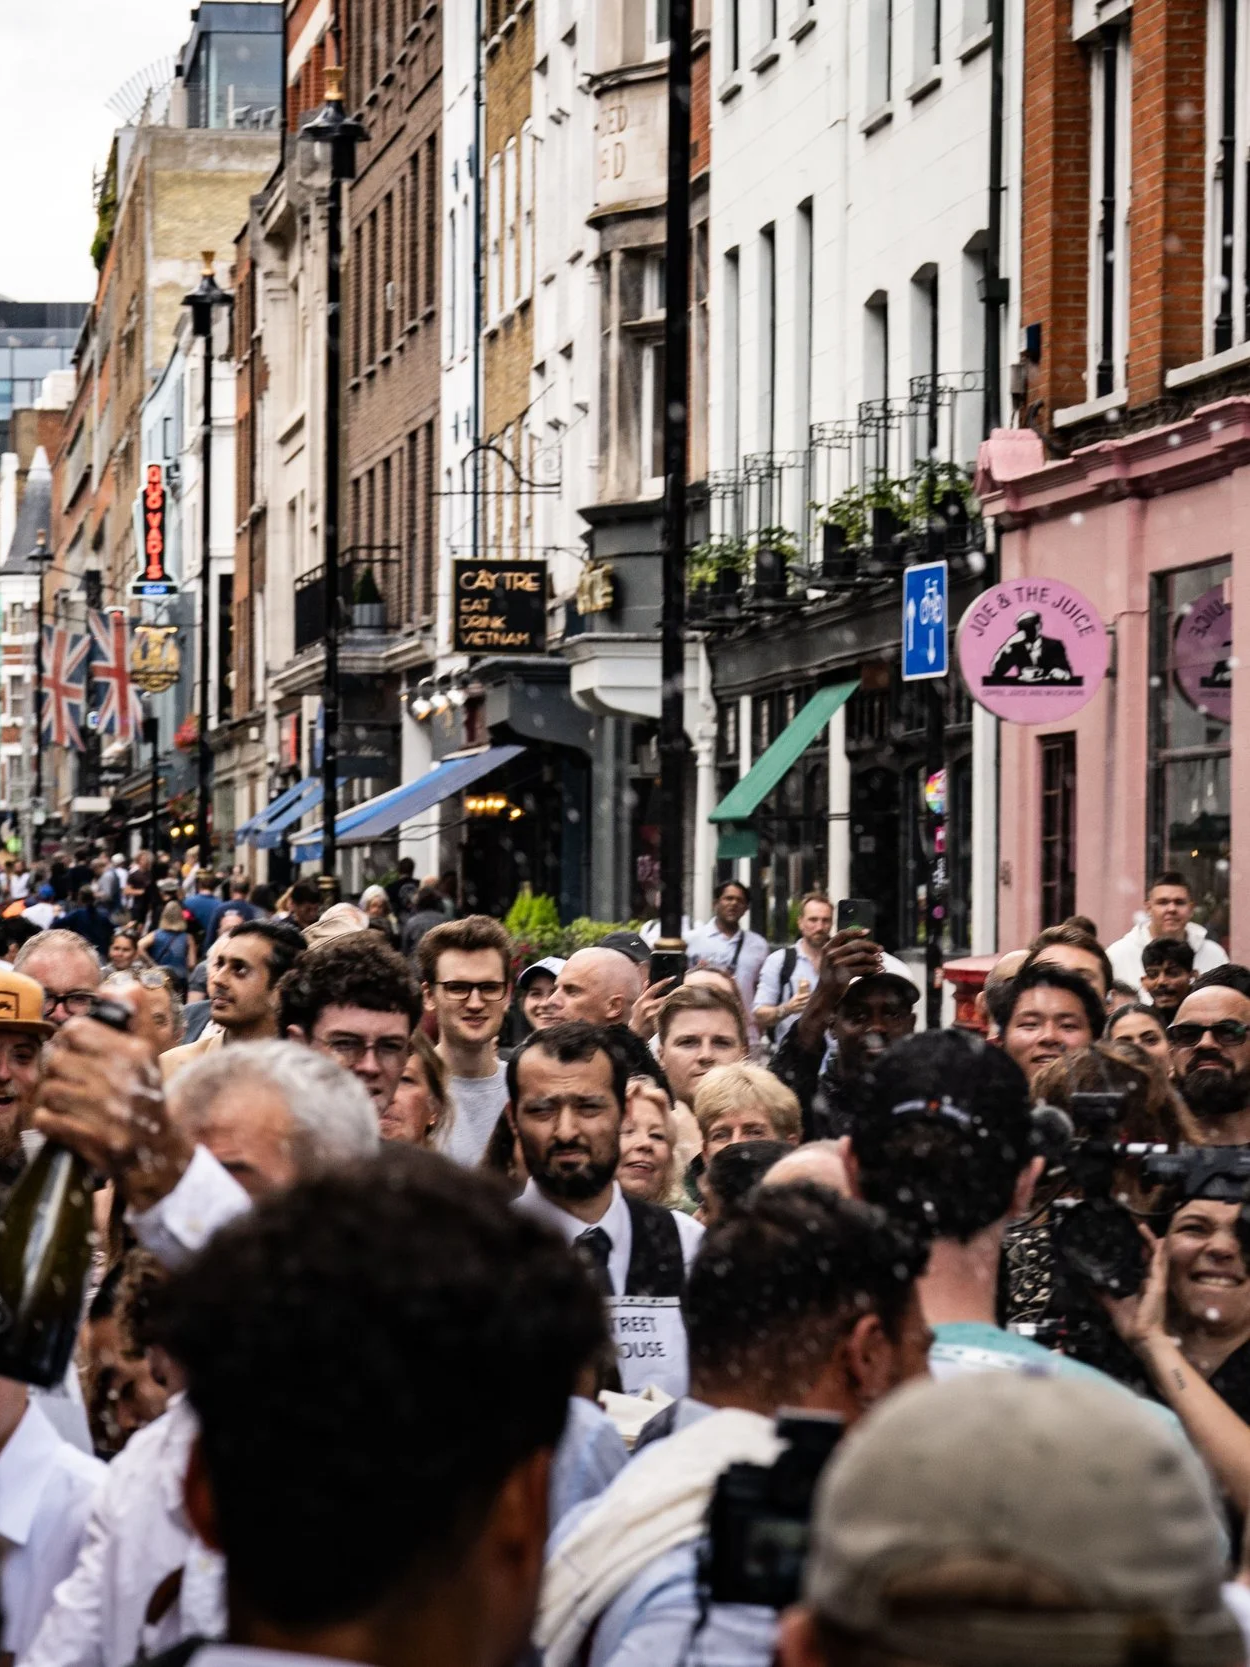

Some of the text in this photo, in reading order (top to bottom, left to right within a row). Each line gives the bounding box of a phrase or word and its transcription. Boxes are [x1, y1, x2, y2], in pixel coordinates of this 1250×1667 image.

[146, 464, 163, 510] QUO
[146, 511, 163, 579] VADIS
[503, 571, 542, 592] TRE
[459, 597, 492, 612] EAT
[969, 586, 1096, 638] JOE & THE JUICE
[459, 615, 508, 630] DRINK
[459, 631, 531, 646] VIETNAM
[609, 1316, 656, 1333] TREET
[618, 1341, 666, 1359] OUSE
